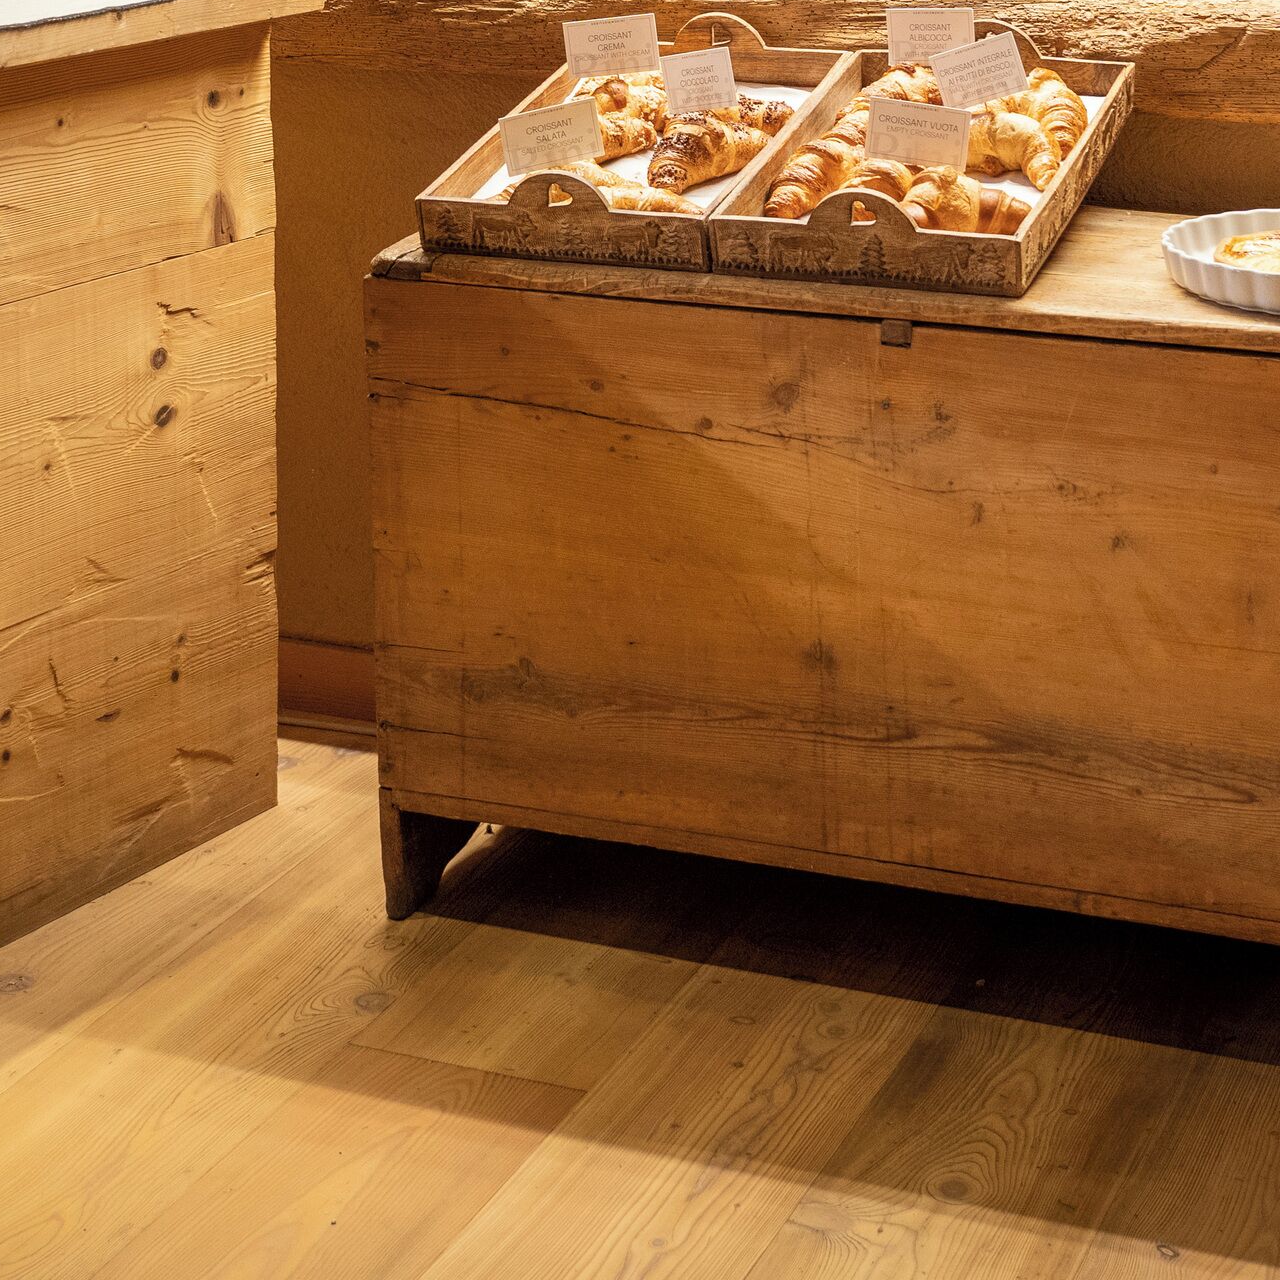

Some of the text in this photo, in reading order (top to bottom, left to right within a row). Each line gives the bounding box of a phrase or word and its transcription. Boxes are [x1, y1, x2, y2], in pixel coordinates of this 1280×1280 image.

[588, 31, 633, 43] CROISSANT
[909, 33, 952, 41] ALBICOCCA
[598, 42, 626, 52] CREMA
[940, 60, 976, 78] CROISSANT
[977, 48, 1013, 65] INTEGRALE
[681, 65, 714, 77] CROISSANT
[526, 118, 573, 135] CROISSANT
[879, 114, 959, 133] CROISSANT VUOTA
[536, 130, 567, 144] SALATA
